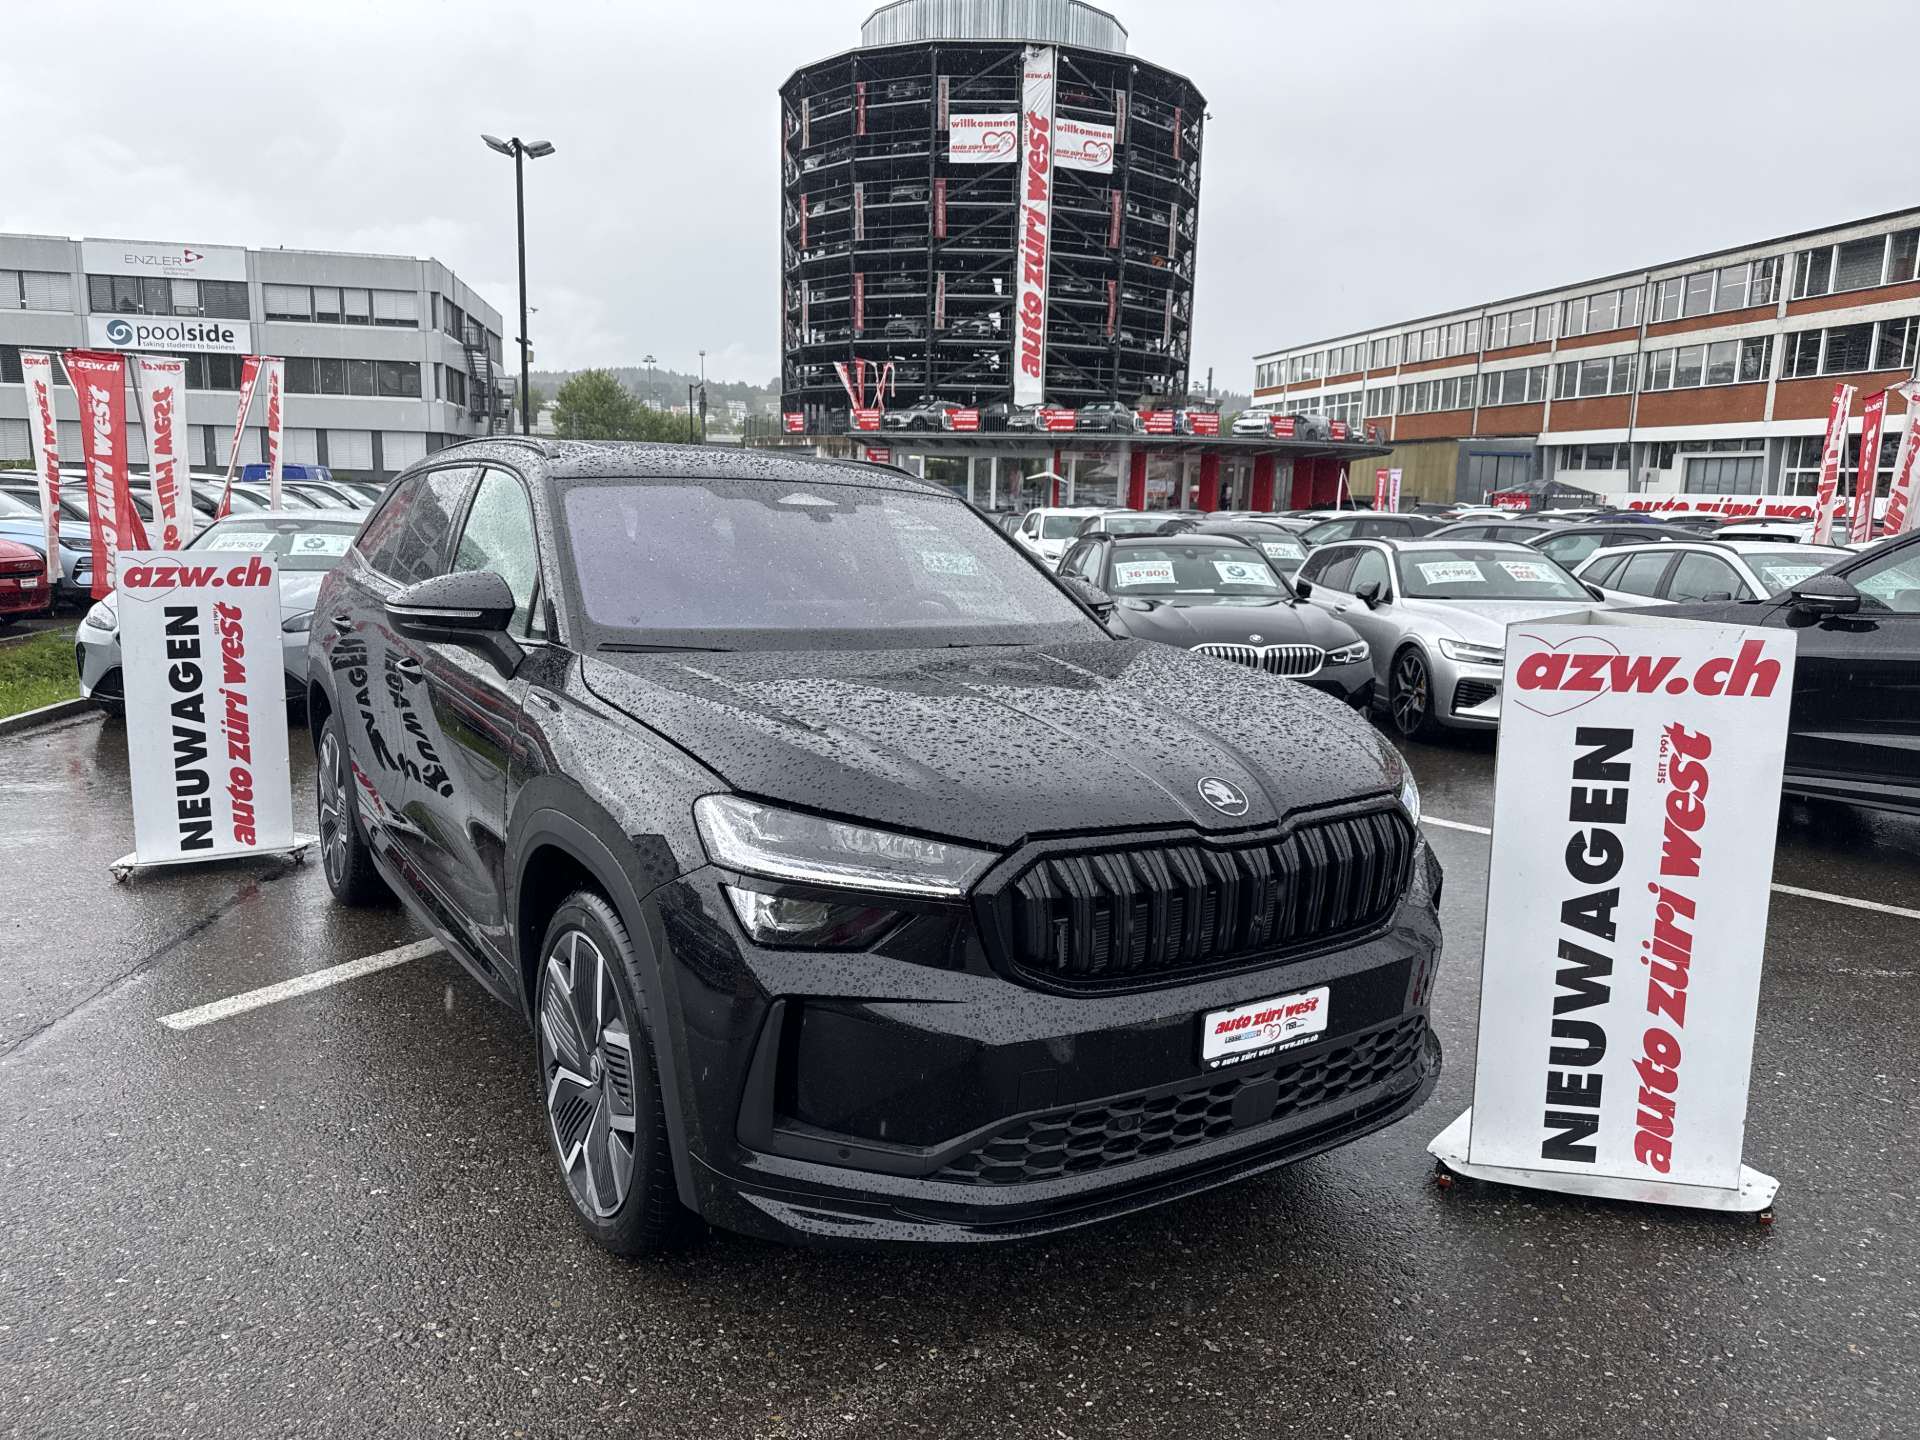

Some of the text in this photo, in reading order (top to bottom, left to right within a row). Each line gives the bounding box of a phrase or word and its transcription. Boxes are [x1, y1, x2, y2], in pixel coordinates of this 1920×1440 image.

[951, 118, 1016, 128] willkommen
[1056, 123, 1113, 139] willkommen
[124, 254, 182, 266] ENZLER
[1019, 110, 1050, 378] auto züri west
[136, 322, 235, 347] poolside
[166, 342, 196, 350] students
[206, 343, 235, 351] business
[78, 358, 121, 372] azw.ch
[88, 384, 113, 456] west
[89, 456, 117, 525] züri
[1628, 495, 1690, 512] auto
[1695, 496, 1763, 516] züri
[123, 556, 272, 588] azw.ch
[1516, 639, 1781, 698] azw.ch
[164, 605, 214, 851] NEUWAGEN
[212, 601, 257, 846] auto züri west
[1657, 734, 1670, 784] SEIT 1991
[1541, 726, 1634, 1163] NEUWAGEN
[1631, 721, 1712, 1174] auto züri west
[1215, 1014, 1252, 1035] auto
[1251, 1003, 1286, 1027] züri
[1285, 997, 1320, 1018] west
